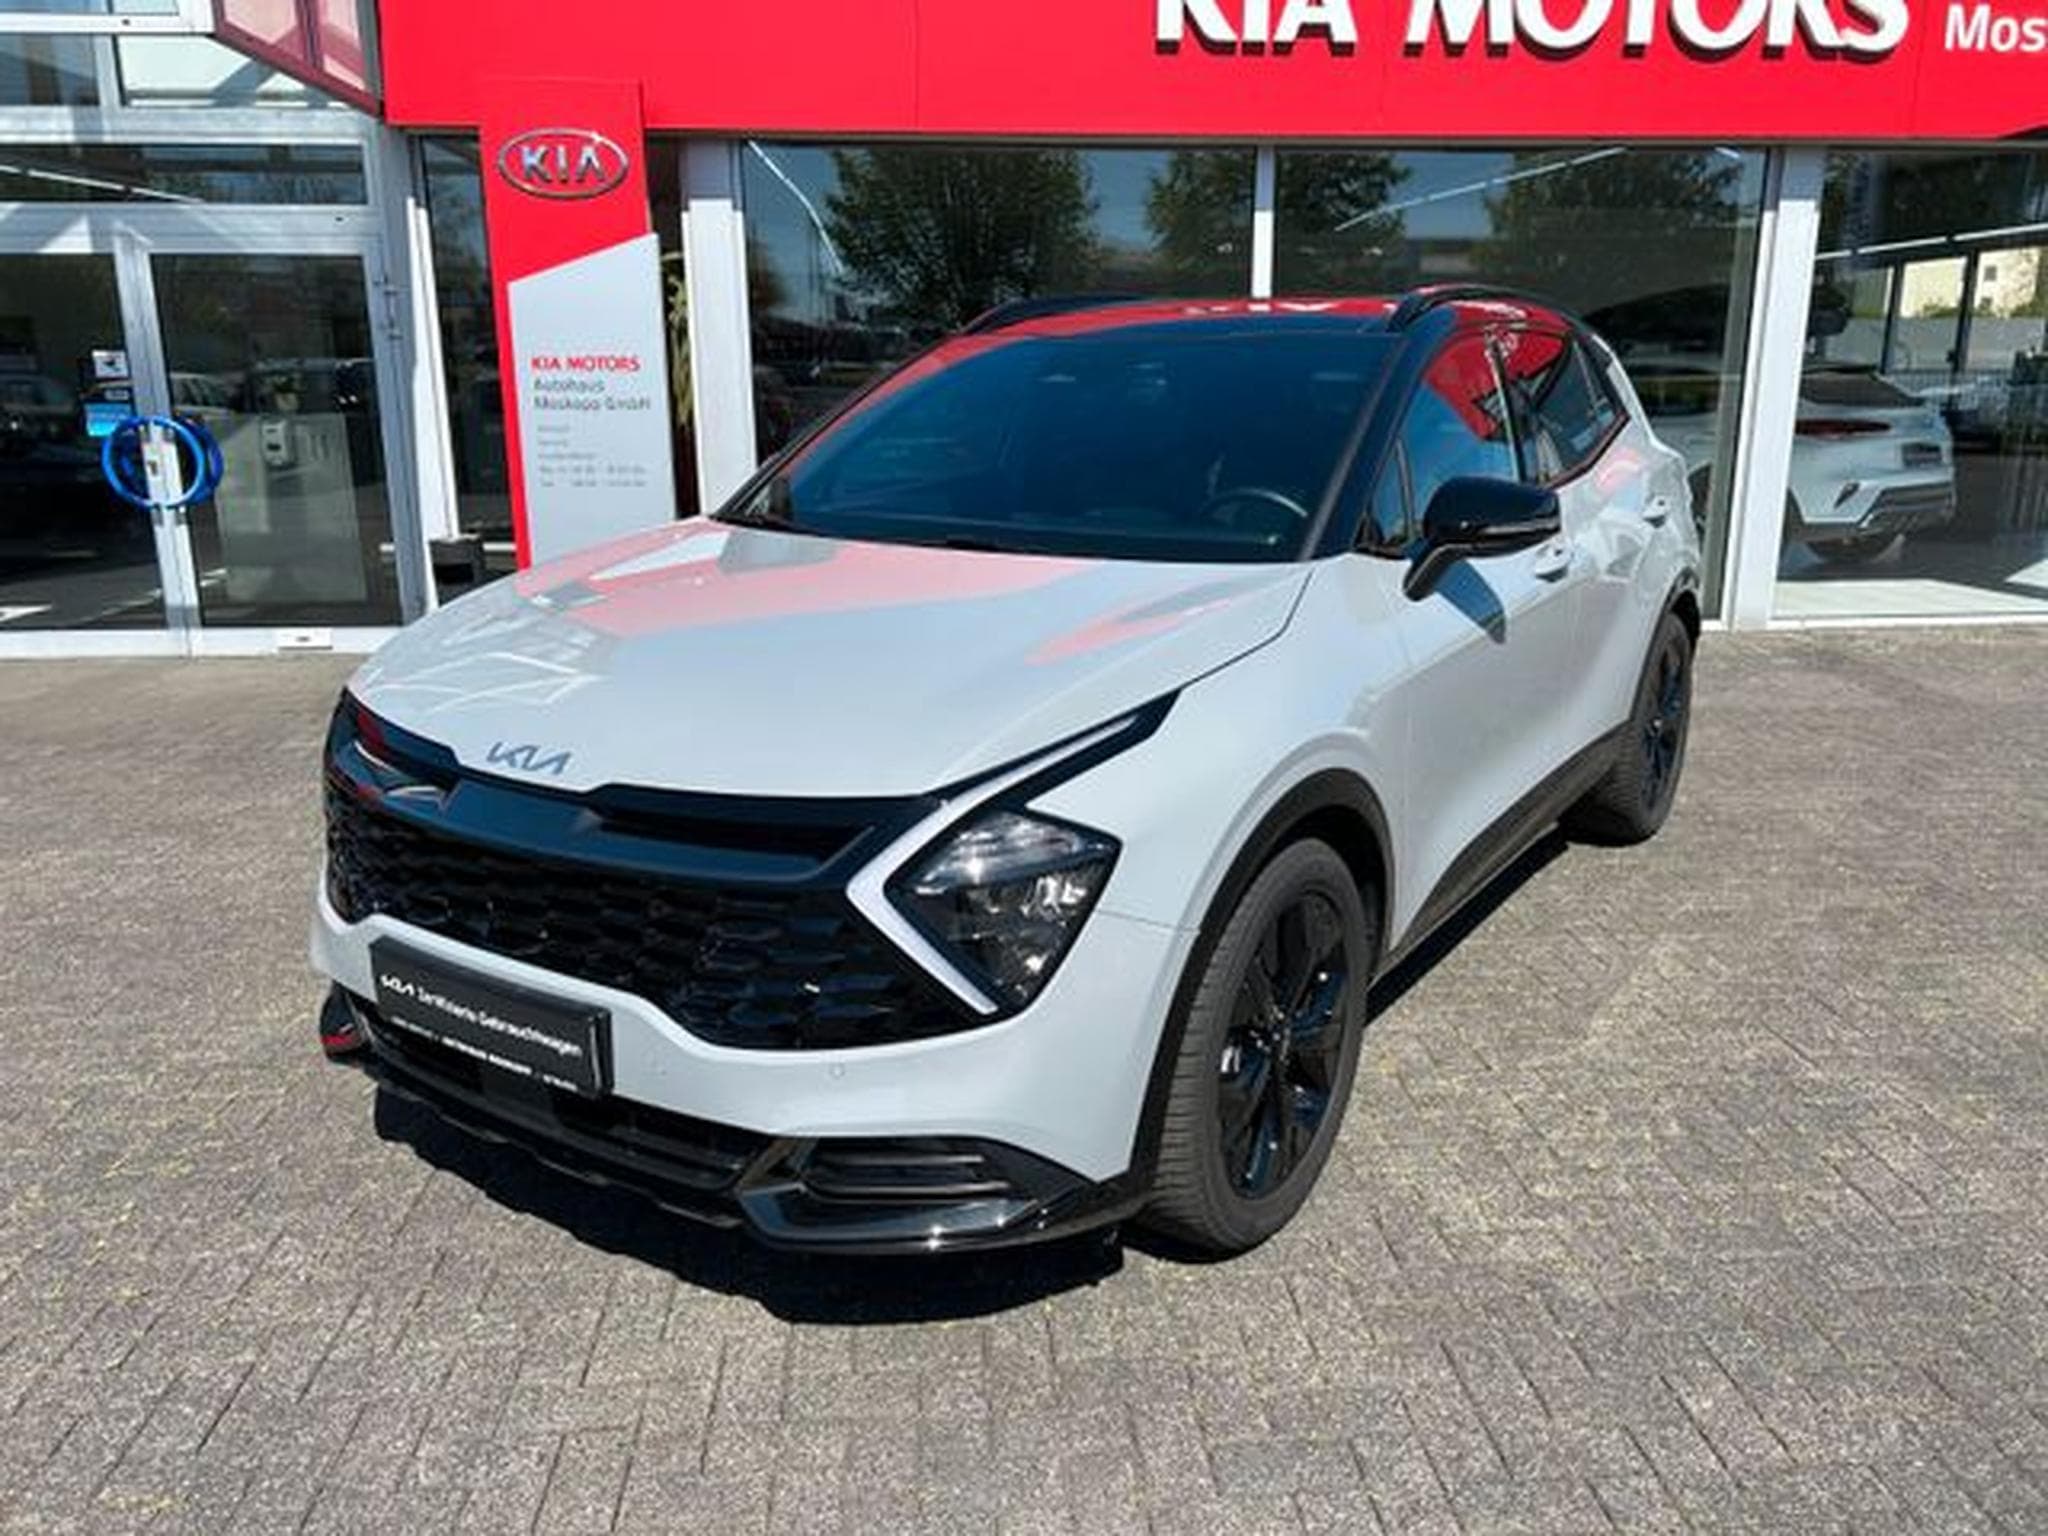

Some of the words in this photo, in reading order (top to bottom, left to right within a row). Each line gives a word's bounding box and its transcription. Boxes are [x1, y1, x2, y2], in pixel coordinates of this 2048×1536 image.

[1943, 2, 2048, 51] Mos
[521, 144, 605, 183] KIA
[531, 355, 561, 372] KIA
[567, 355, 641, 372] MOTORS
[534, 378, 605, 393] Autohaus
[486, 741, 571, 775] KIA
